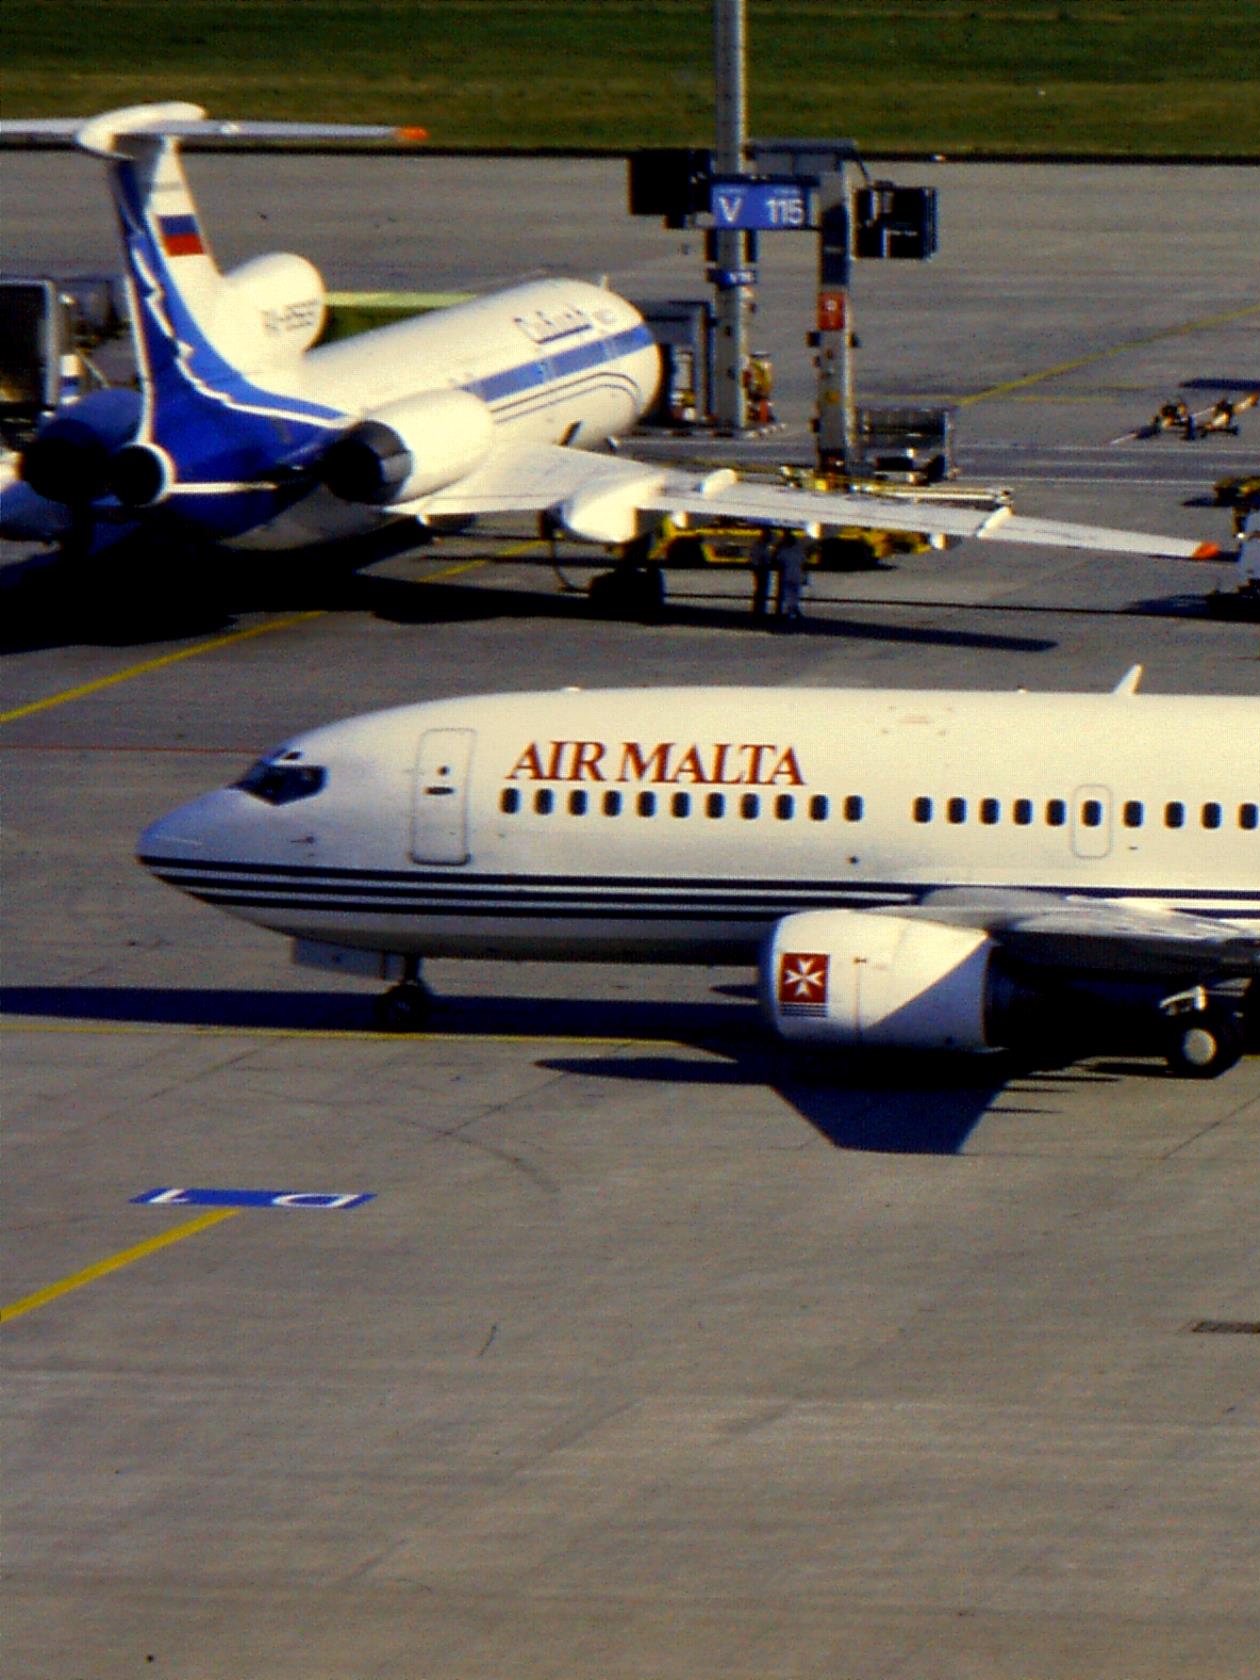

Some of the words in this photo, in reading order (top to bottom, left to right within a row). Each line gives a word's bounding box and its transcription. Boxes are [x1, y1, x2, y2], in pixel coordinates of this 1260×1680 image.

[719, 196, 742, 223] V
[766, 198, 804, 225] 115
[505, 740, 606, 782] AIR
[615, 742, 805, 786] MALTA
